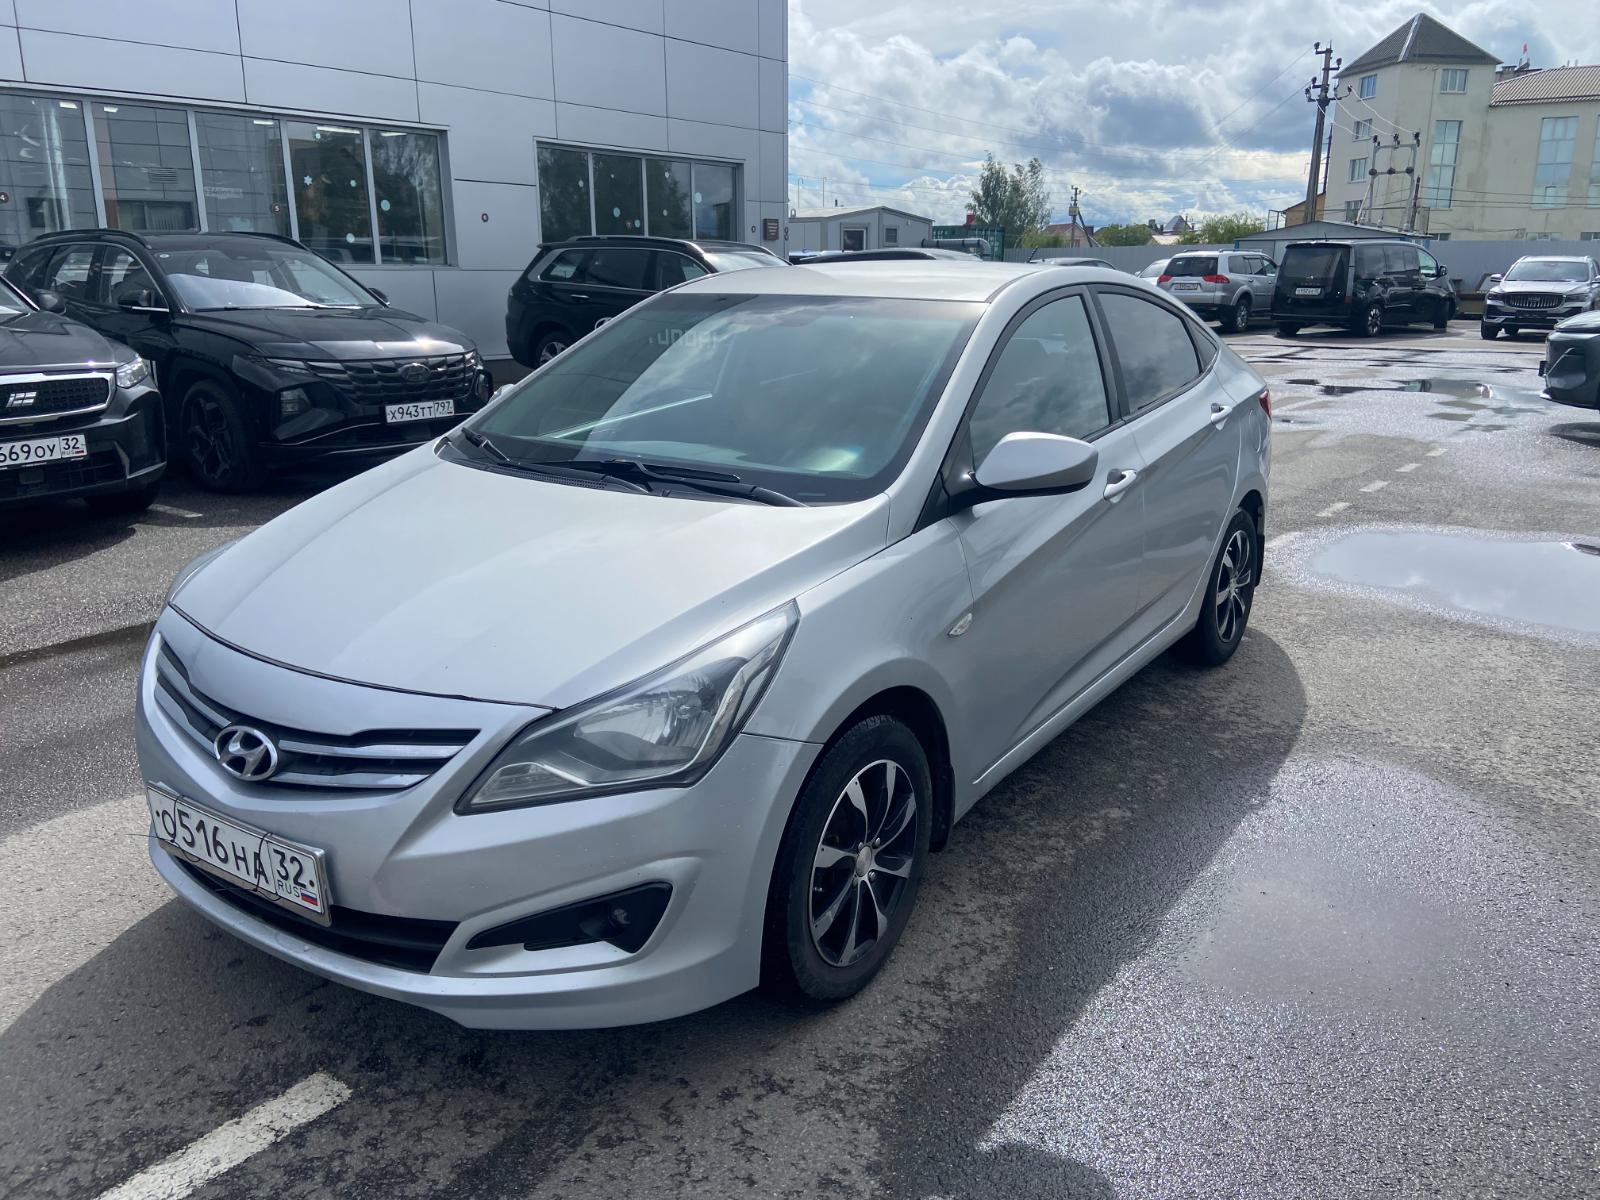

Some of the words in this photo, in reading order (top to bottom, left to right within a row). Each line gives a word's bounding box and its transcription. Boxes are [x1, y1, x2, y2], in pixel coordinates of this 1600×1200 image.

[62, 437, 80, 450] 32
[272, 849, 307, 889] 32
[276, 882, 300, 899] RUS
